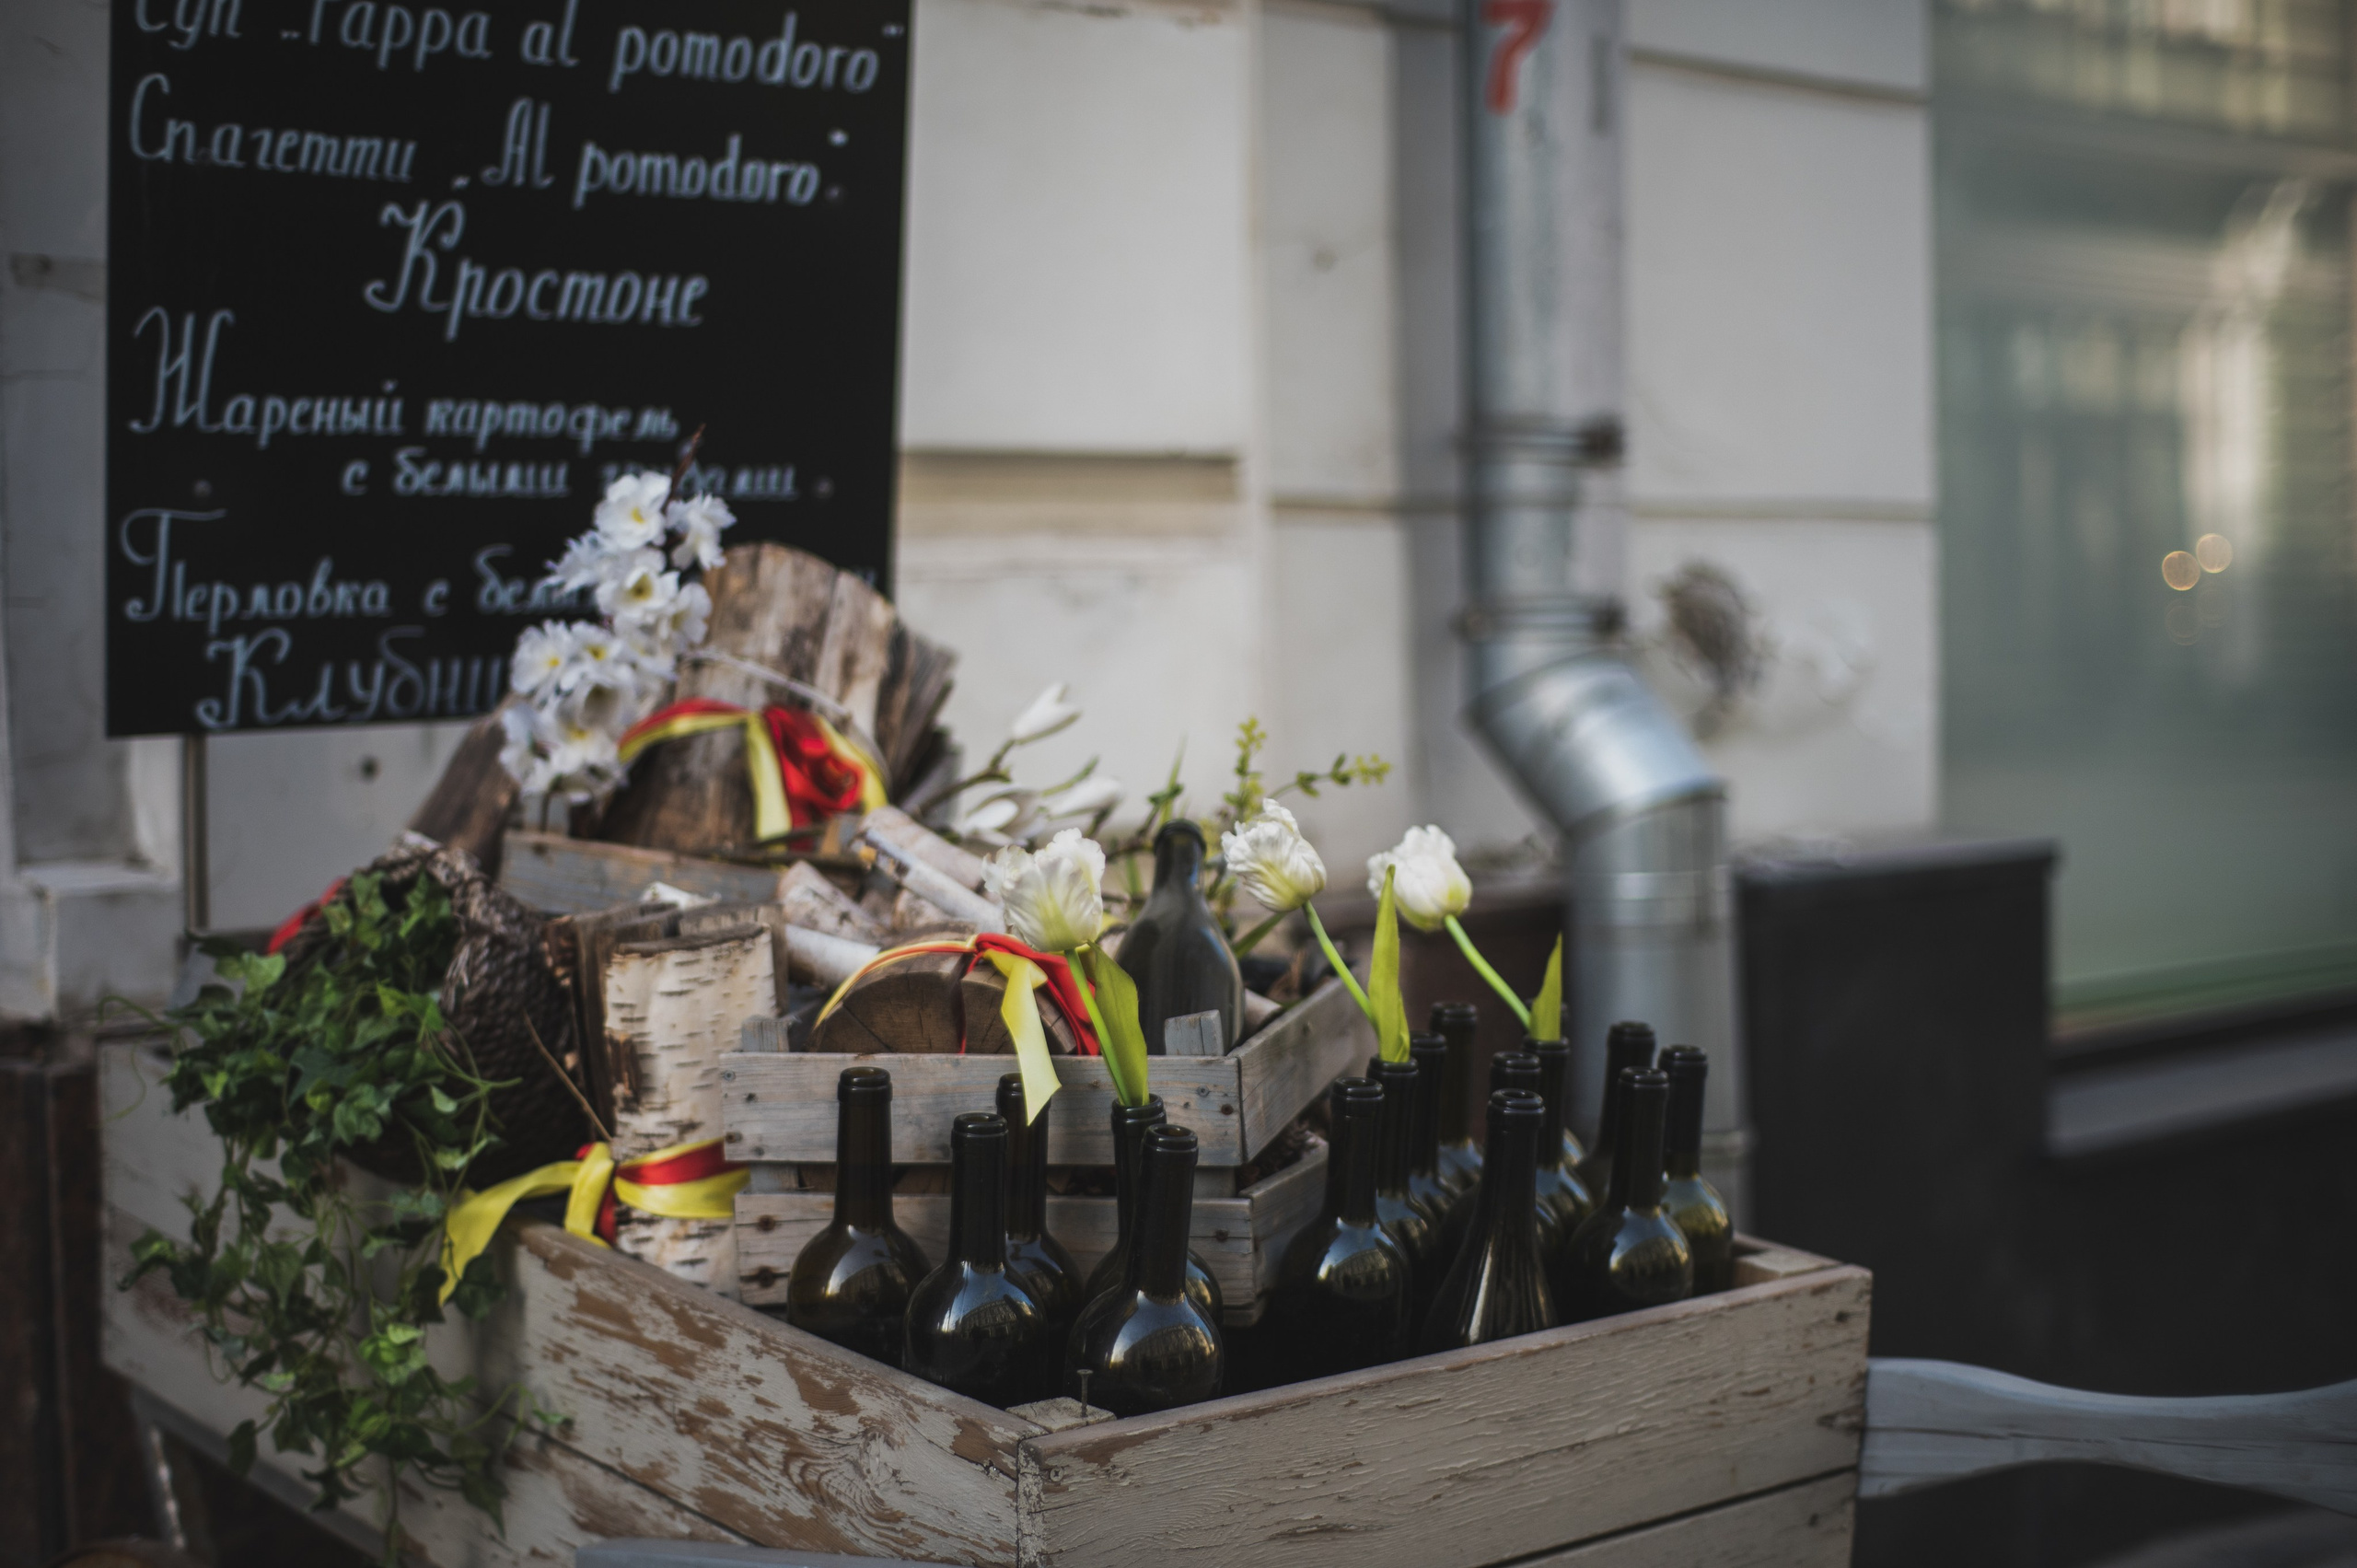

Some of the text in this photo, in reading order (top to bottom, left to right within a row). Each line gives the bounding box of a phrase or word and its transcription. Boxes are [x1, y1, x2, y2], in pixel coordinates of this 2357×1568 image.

[520, 0, 580, 66] al
[129, 72, 419, 182] Спагетти
[365, 201, 709, 340] Кростоне
[127, 305, 681, 454] Жареный картофель
[341, 459, 369, 497] с
[393, 446, 573, 497] белыми
[121, 507, 391, 635] Перловка
[423, 577, 452, 618] с
